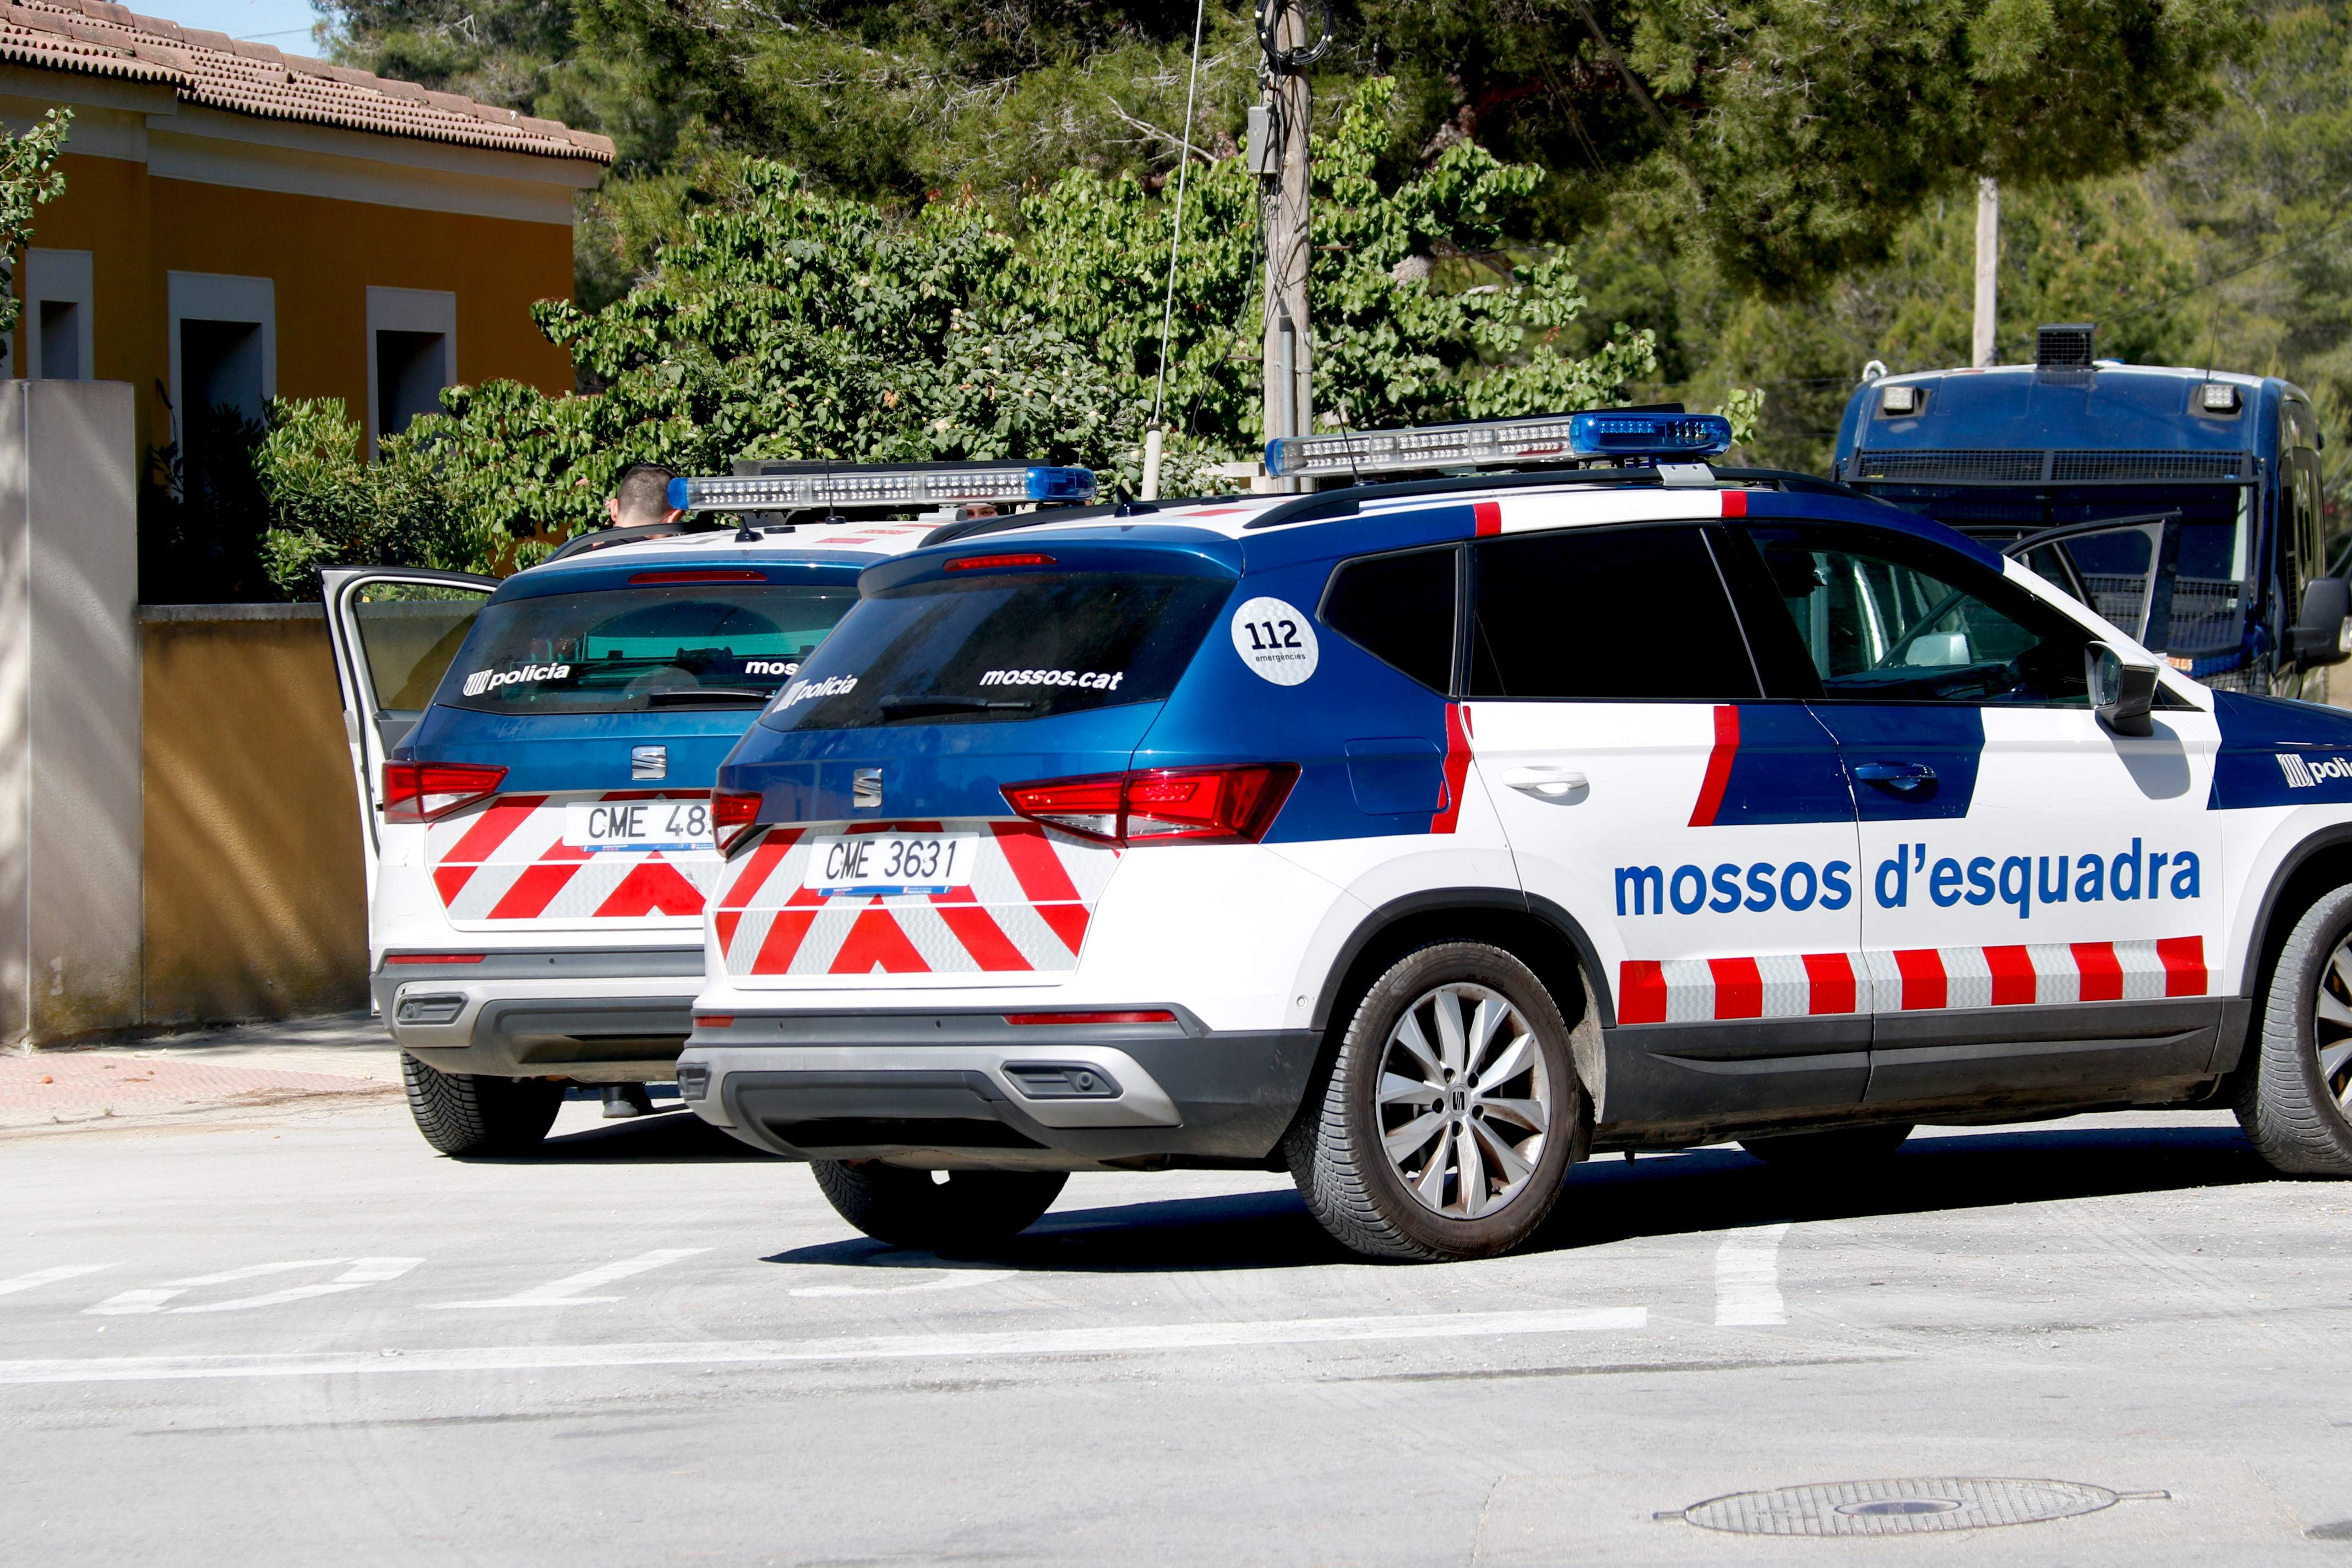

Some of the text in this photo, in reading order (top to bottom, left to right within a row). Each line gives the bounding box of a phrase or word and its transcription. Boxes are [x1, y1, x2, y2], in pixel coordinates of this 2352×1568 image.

[1245, 620, 1302, 650] 112
[487, 662, 570, 691] policia
[791, 674, 858, 706] policia
[979, 669, 1124, 690] mossos.cat
[2307, 757, 2352, 783] poli
[589, 805, 712, 839] CME 48
[826, 840, 957, 880] CME 3631
[1615, 837, 2200, 919] mossos d'esquadra
